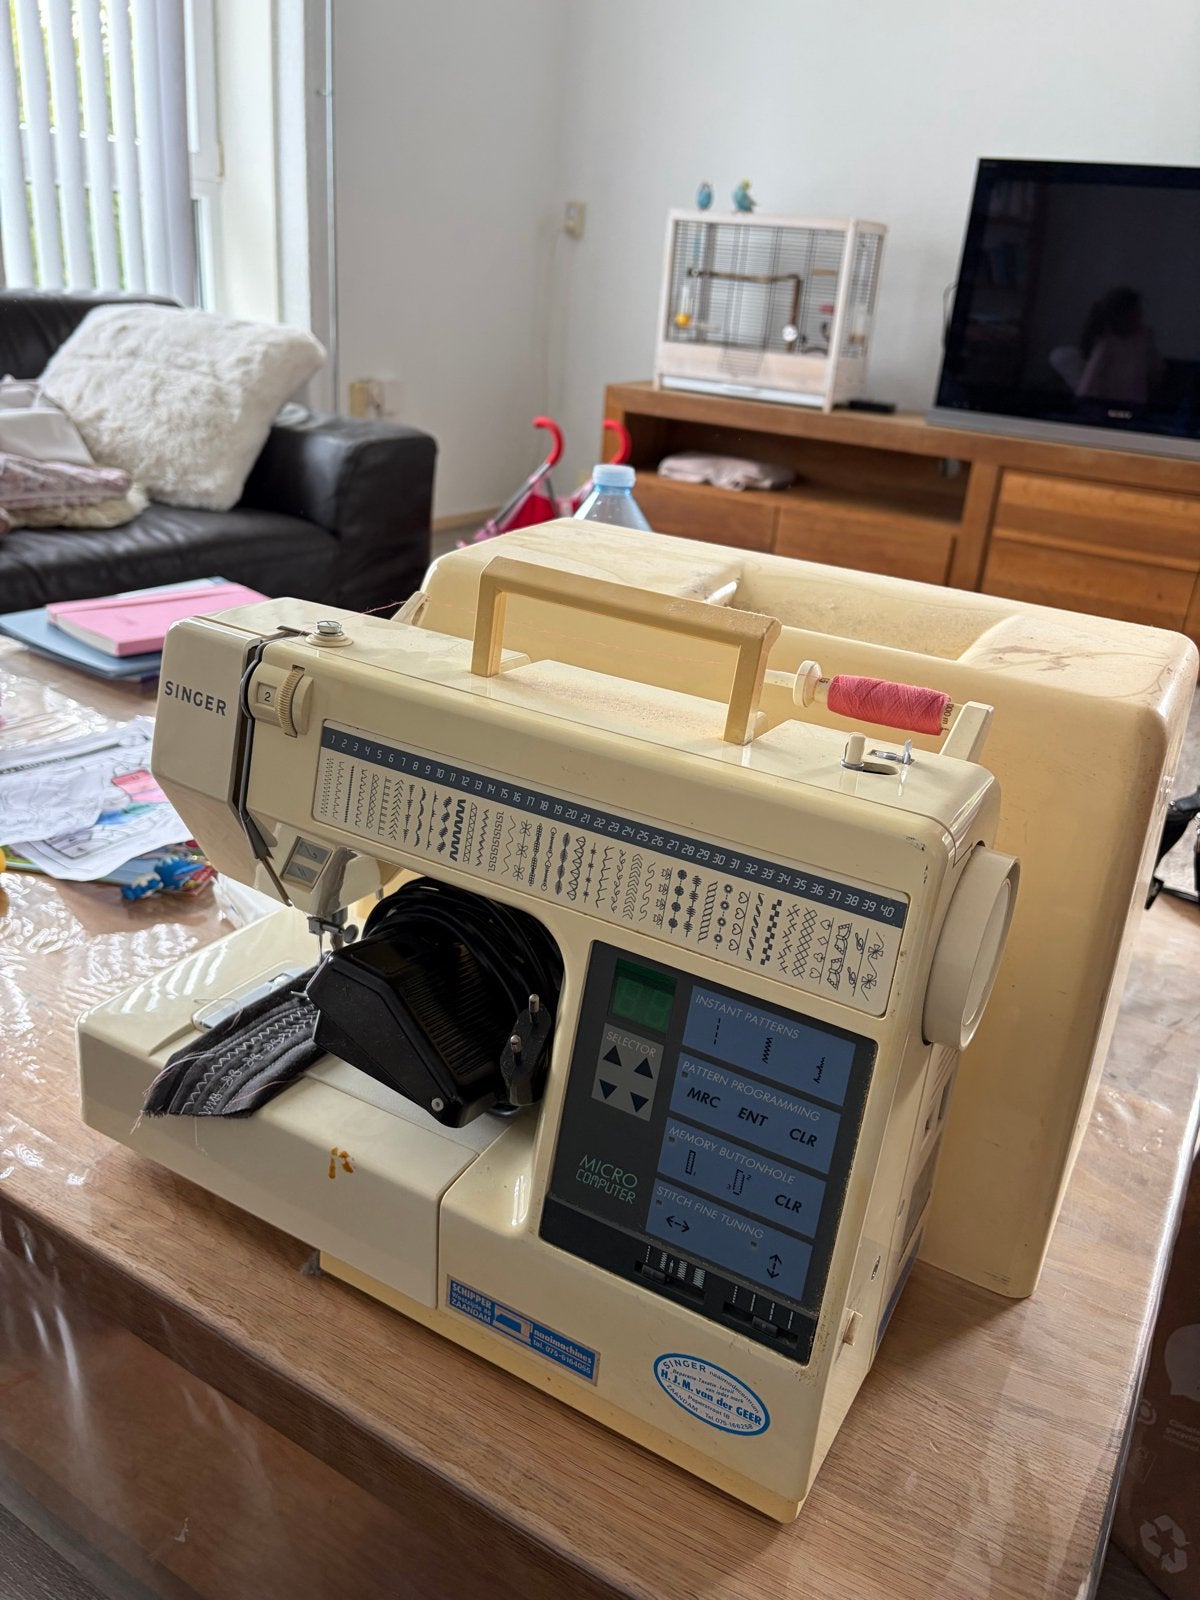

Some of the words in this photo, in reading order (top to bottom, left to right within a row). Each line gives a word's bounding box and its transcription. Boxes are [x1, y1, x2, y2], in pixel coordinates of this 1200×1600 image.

[164, 680, 227, 717] SINGER
[264, 691, 271, 703] 2
[330, 735, 336, 744] 1
[341, 738, 348, 748] 2
[351, 742, 359, 752] 3
[364, 746, 371, 755] 4
[376, 749, 382, 759] 5
[388, 753, 394, 763] 6
[400, 757, 407, 766] 7
[412, 761, 419, 771] 8
[424, 764, 431, 774] 9
[435, 768, 445, 779] 10
[449, 772, 456, 782] 11
[461, 775, 470, 786] 12
[474, 779, 483, 790] 13
[486, 783, 496, 794] 14
[500, 787, 509, 799] 15
[512, 791, 522, 803] 16
[526, 795, 535, 807] 17
[539, 800, 549, 811] 18
[553, 804, 563, 815] 19
[564, 808, 578, 820] 20
[580, 812, 591, 824] 21
[593, 817, 606, 829] 22
[607, 821, 620, 833] 23
[621, 825, 635, 837] 24
[636, 829, 650, 842] 25
[650, 834, 664, 847] 26
[666, 839, 680, 851] 27
[681, 843, 695, 856] 28
[695, 848, 711, 861] 29
[712, 853, 726, 865] 30
[729, 858, 741, 870] 31
[744, 862, 758, 875] 32
[760, 867, 776, 880] 33
[776, 872, 791, 885] 34
[792, 877, 807, 890] 35
[809, 882, 824, 896] 36
[827, 888, 842, 901] 37
[844, 893, 860, 906] 38
[861, 899, 877, 912] 39
[880, 904, 895, 918] 40
[695, 994, 744, 1019] INSTANT
[744, 1012, 800, 1040] PATTERNS
[606, 1031, 657, 1058] SELECTOR
[682, 1060, 729, 1086] PATTERN
[730, 1079, 821, 1121] PROGRAMMING
[687, 1087, 721, 1109] MRC
[737, 1106, 769, 1127] ENT
[669, 1126, 718, 1152] MEMORY
[719, 1146, 796, 1185] BUTTONHOLE
[789, 1128, 818, 1148] CLR
[575, 1168, 637, 1205] COMPUTER
[579, 1153, 638, 1189] MICRO
[656, 1185, 693, 1208] STITCH
[694, 1202, 719, 1220] FINE
[720, 1213, 765, 1239] TUNING
[774, 1194, 803, 1214] CLR
[451, 1298, 491, 1324] ZAANDAM
[452, 1283, 491, 1309] SCHIPPER
[533, 1329, 592, 1364] naaimachines
[662, 1359, 706, 1373] SINGER
[695, 1388, 714, 1402] van
[716, 1397, 734, 1411] der
[735, 1406, 762, 1426] GEER
